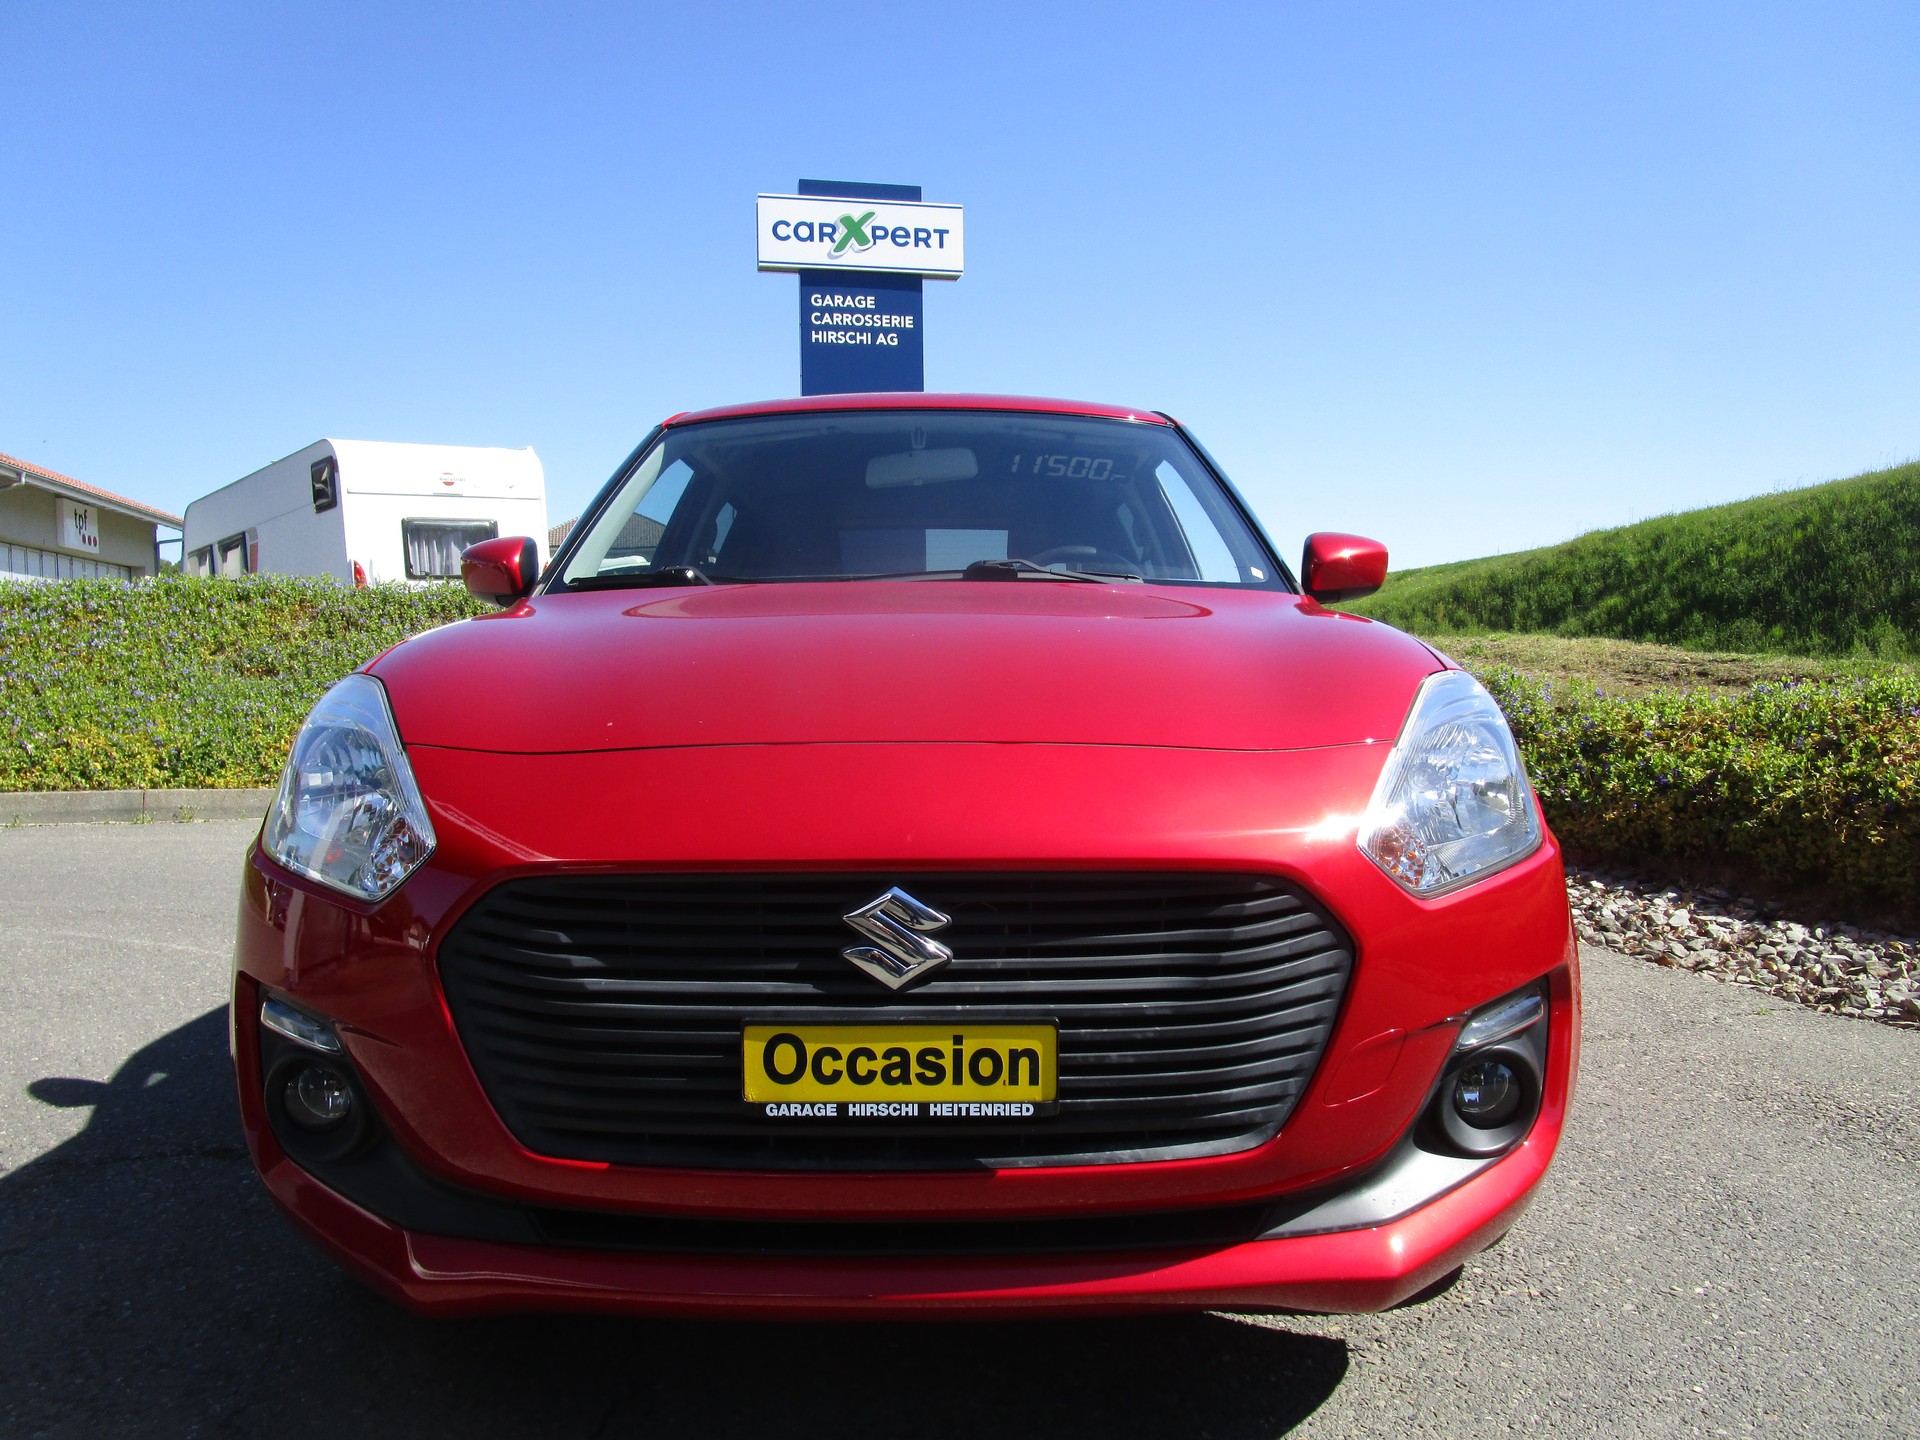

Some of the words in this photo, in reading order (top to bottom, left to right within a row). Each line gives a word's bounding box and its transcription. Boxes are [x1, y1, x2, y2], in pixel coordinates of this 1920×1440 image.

[810, 294, 876, 309] GARAGE
[810, 312, 914, 328] CARROSSERIE
[811, 330, 872, 345] HIRSCHI
[875, 332, 899, 346] AG
[73, 508, 88, 535] tpf
[762, 1032, 1040, 1086] Occasion
[765, 1103, 838, 1117] GARAGE
[848, 1103, 919, 1117] HIRSCHI
[929, 1103, 1035, 1117] HEITENRIED
